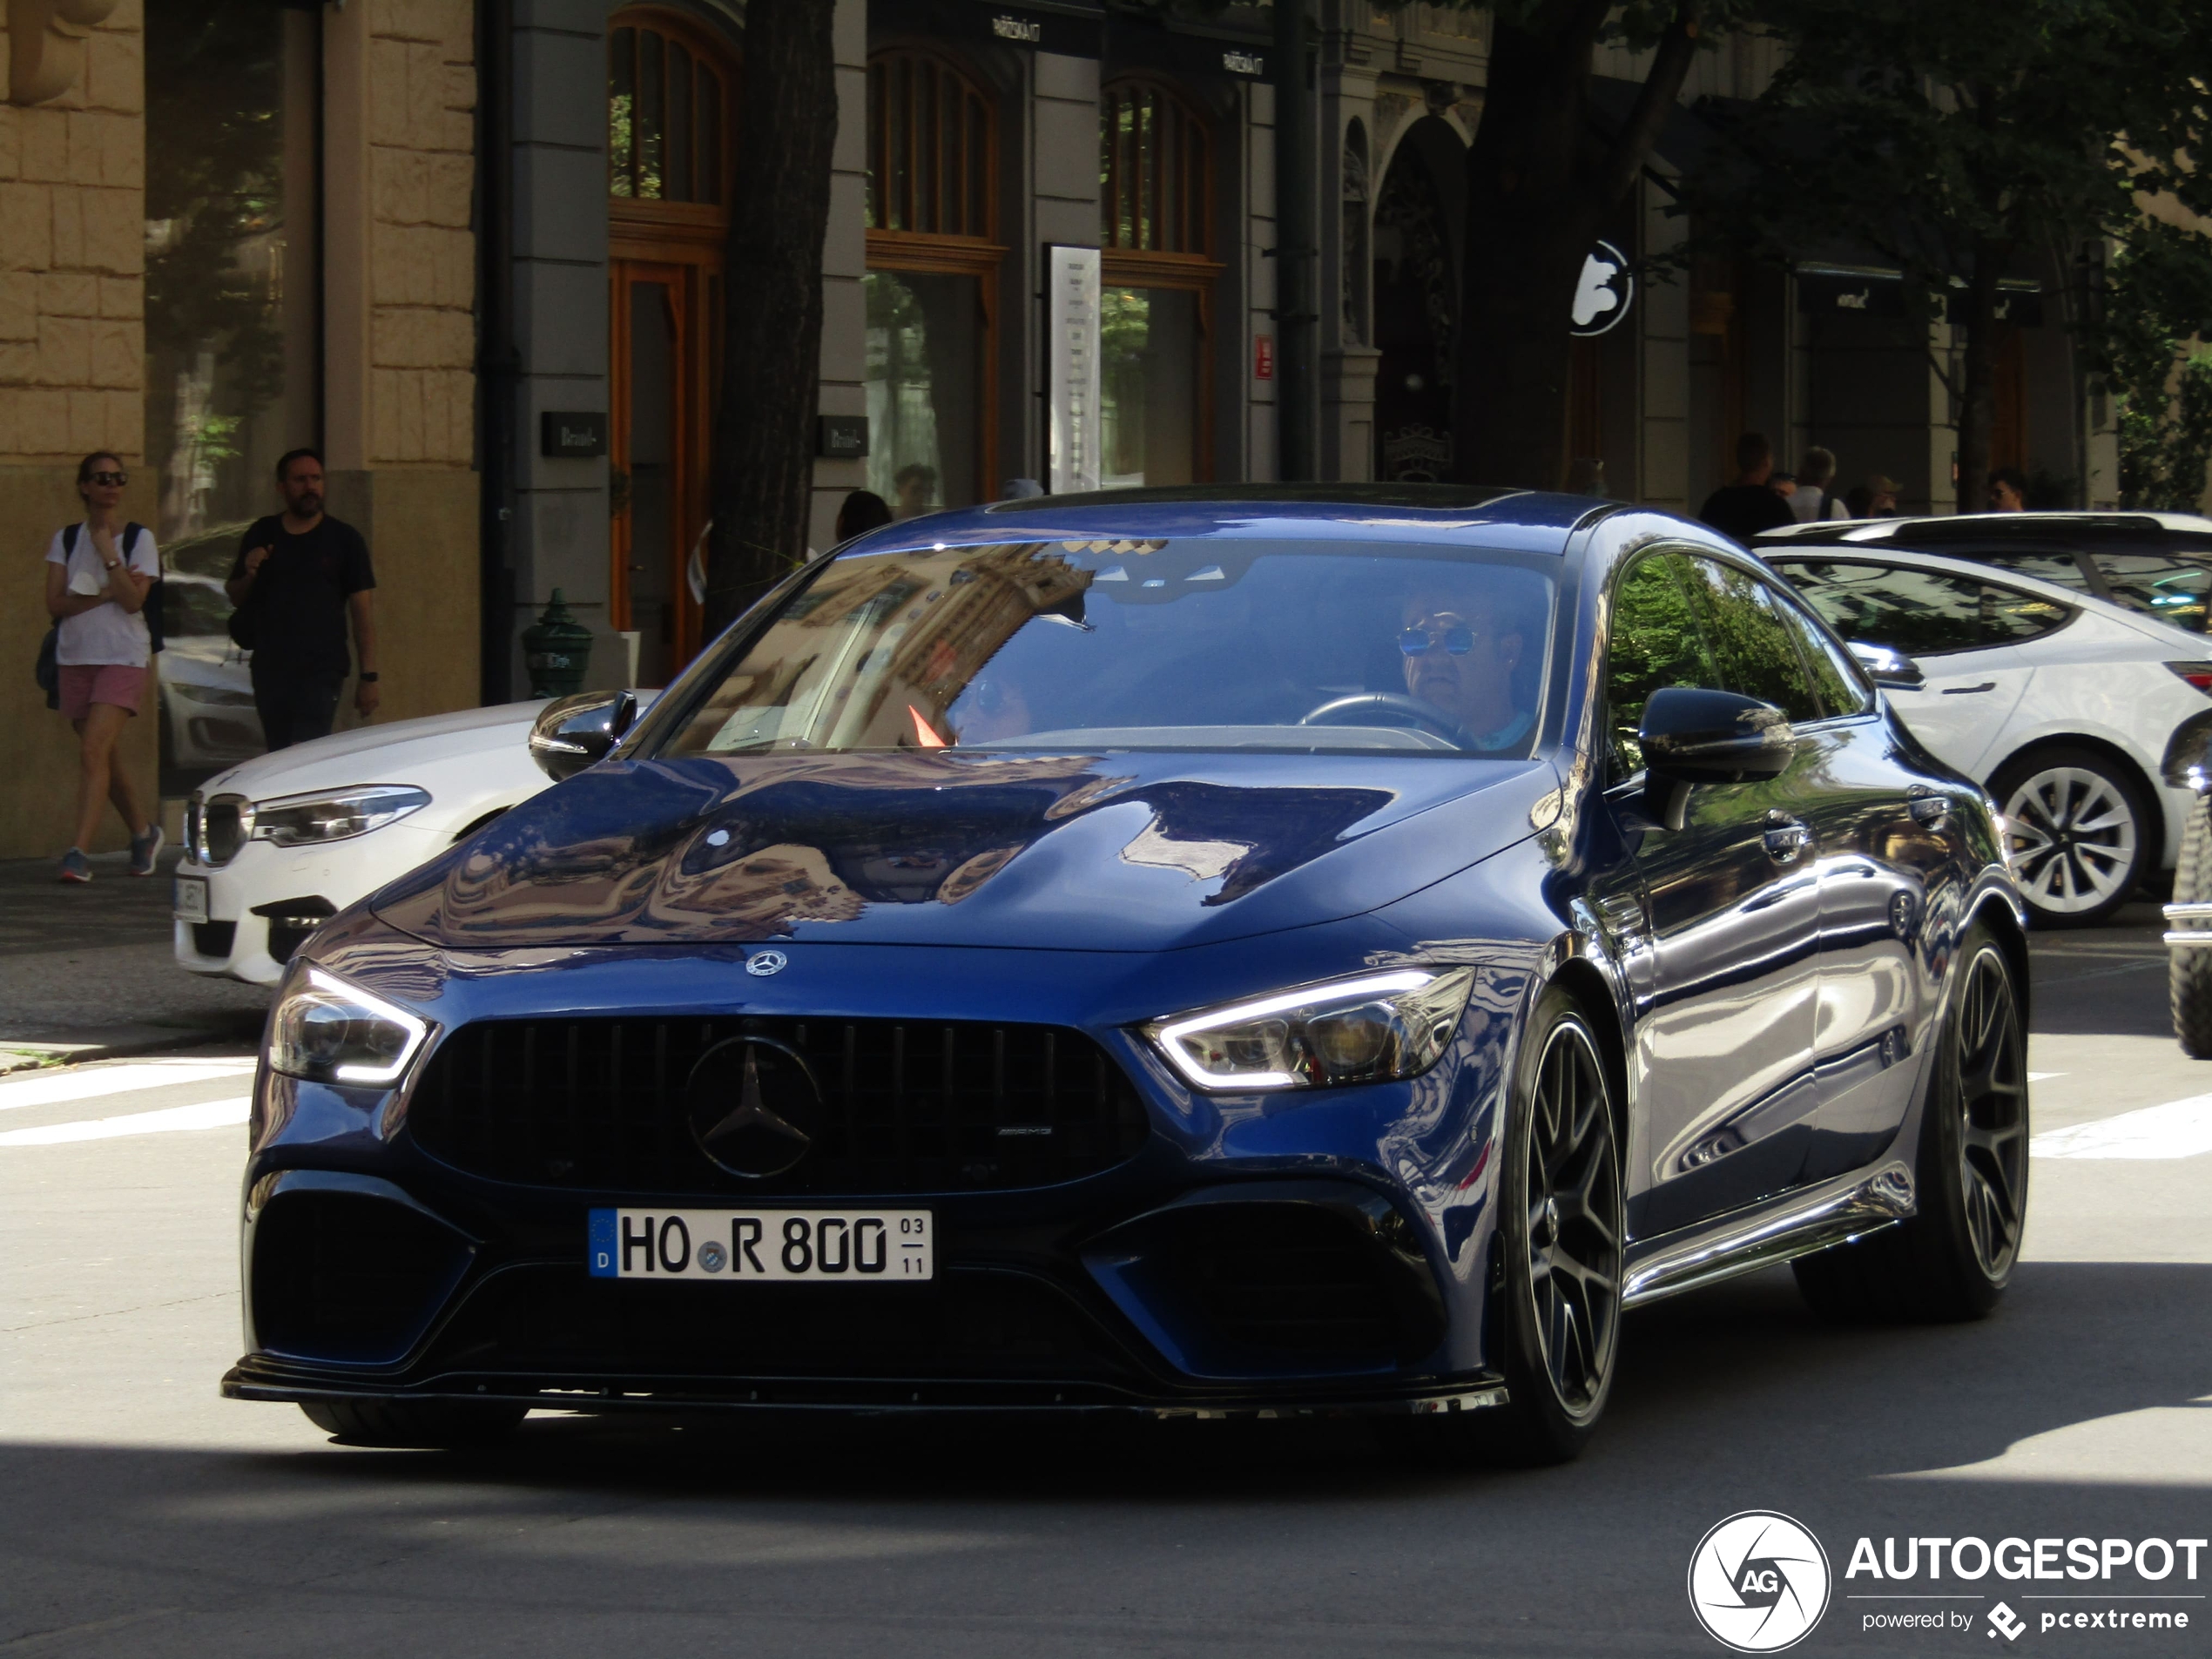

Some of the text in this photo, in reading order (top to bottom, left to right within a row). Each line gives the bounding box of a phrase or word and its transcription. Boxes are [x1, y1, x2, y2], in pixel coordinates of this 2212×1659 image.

[900, 1218, 924, 1234] 03
[622, 1216, 887, 1274] HO R 800
[597, 1252, 609, 1268] D
[903, 1258, 922, 1273] 11
